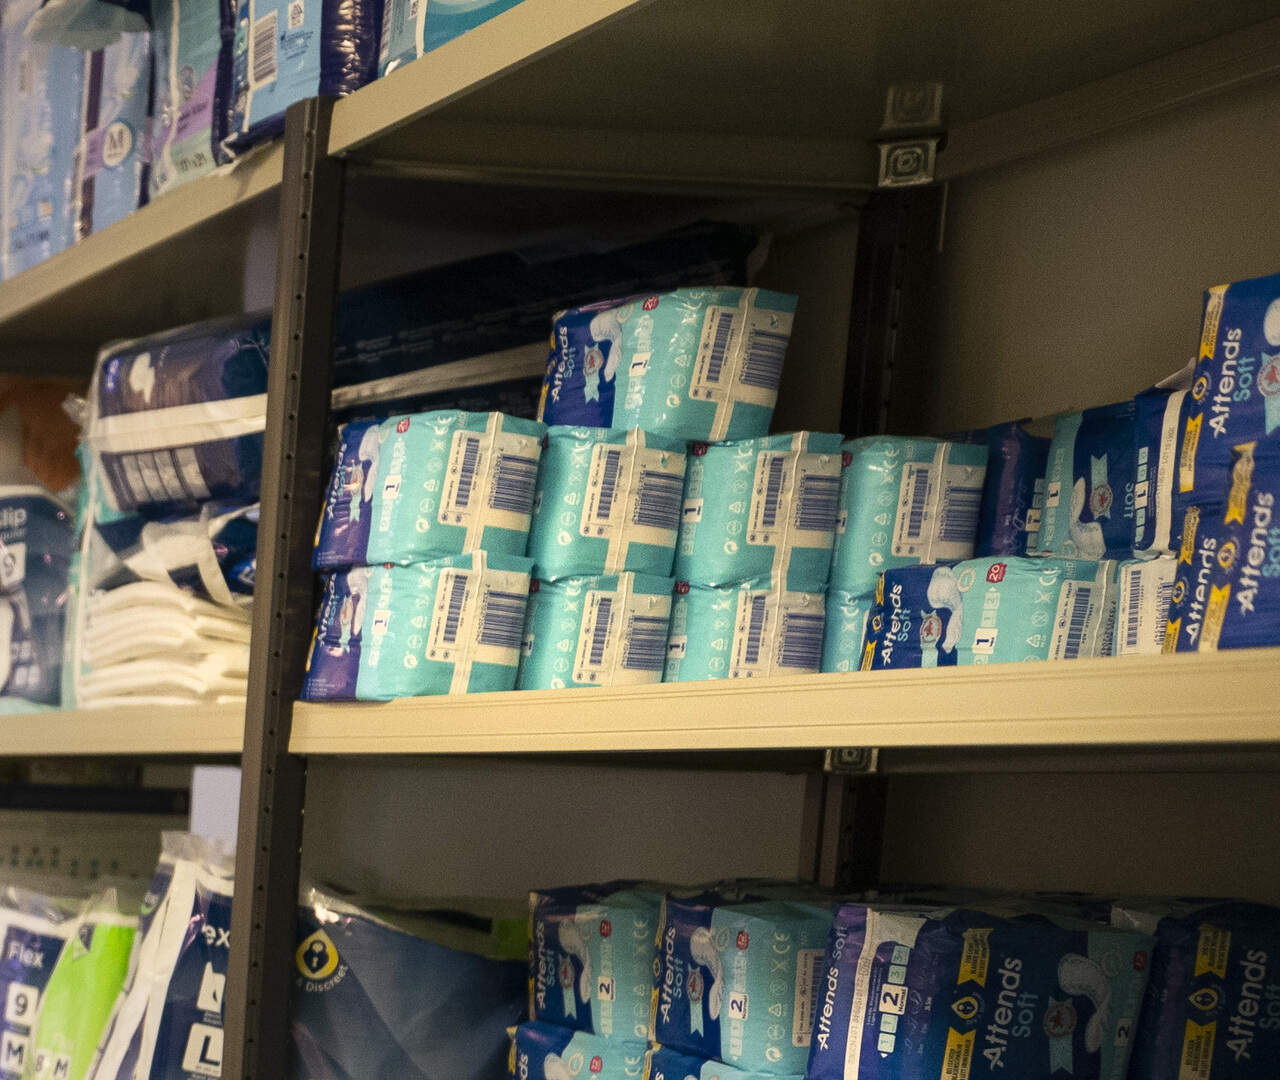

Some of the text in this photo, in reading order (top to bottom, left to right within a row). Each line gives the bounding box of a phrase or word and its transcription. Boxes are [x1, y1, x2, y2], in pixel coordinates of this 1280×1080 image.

[1209, 328, 1242, 439] Attends
[1233, 356, 1256, 402] Soft
[988, 565, 1001, 582] 20
[1236, 491, 1275, 616] Attends
[1186, 537, 1217, 646] Attends
[881, 584, 903, 667] Attends
[898, 607, 912, 641] Soft
[8, 941, 45, 968] Flex
[201, 923, 231, 948] ex
[832, 925, 848, 960] Soft
[305, 964, 349, 993] Discreet
[659, 926, 677, 1025] Attends
[672, 957, 684, 999] Soft
[15, 993, 29, 1016] 9
[816, 966, 839, 1051] Attends
[983, 956, 1023, 1071] Attends
[1012, 991, 1038, 1038] Soft
[1226, 949, 1268, 1063] Attends
[7, 1039, 24, 1066] M
[198, 1034, 220, 1067] L
